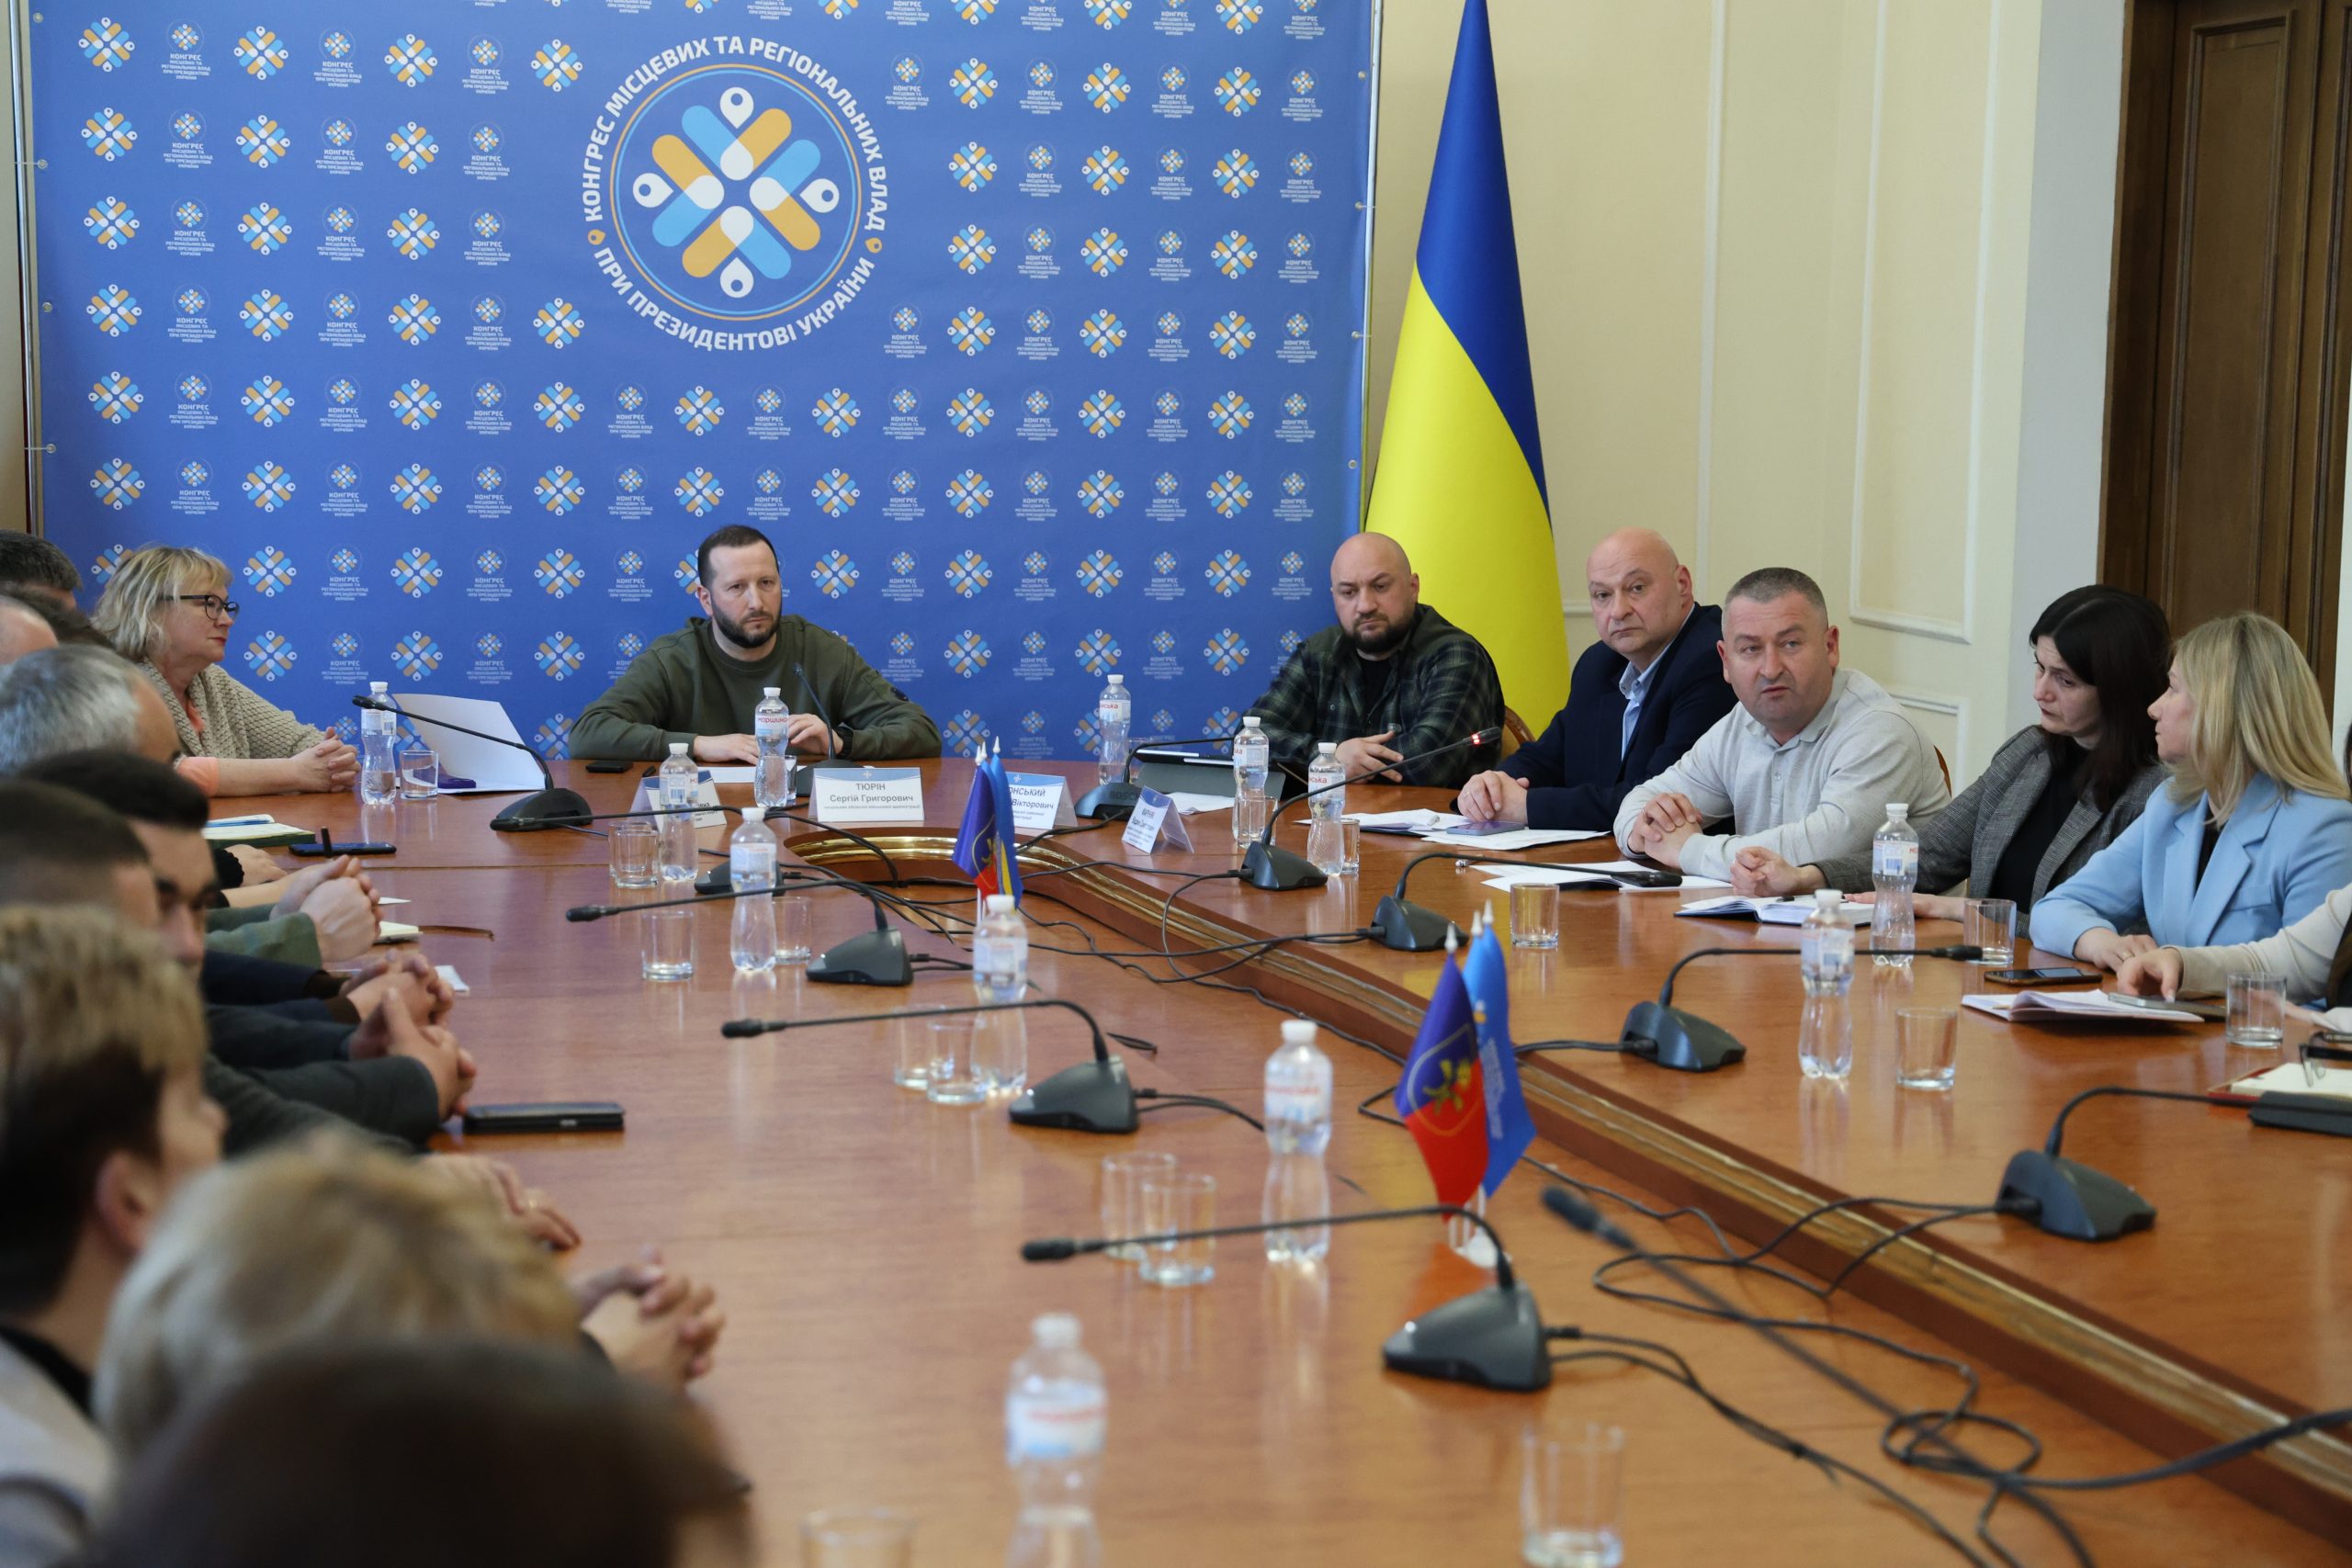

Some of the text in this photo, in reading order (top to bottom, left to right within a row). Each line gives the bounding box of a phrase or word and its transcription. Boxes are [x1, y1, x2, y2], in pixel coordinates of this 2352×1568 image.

[582, 36, 888, 231] КОНГРЕС МІСЦЕВИХ ТА РЕГІОНАЛЬНИХ ВЛАД
[594, 247, 876, 352] ПРИ ПРЕЗИДЕНТОВІ УКРАЇНИ
[1009, 787, 1046, 796] ОНСЬКИЙ
[830, 795, 913, 804] Сергій Григорович
[1012, 799, 1054, 809] Вікторович
